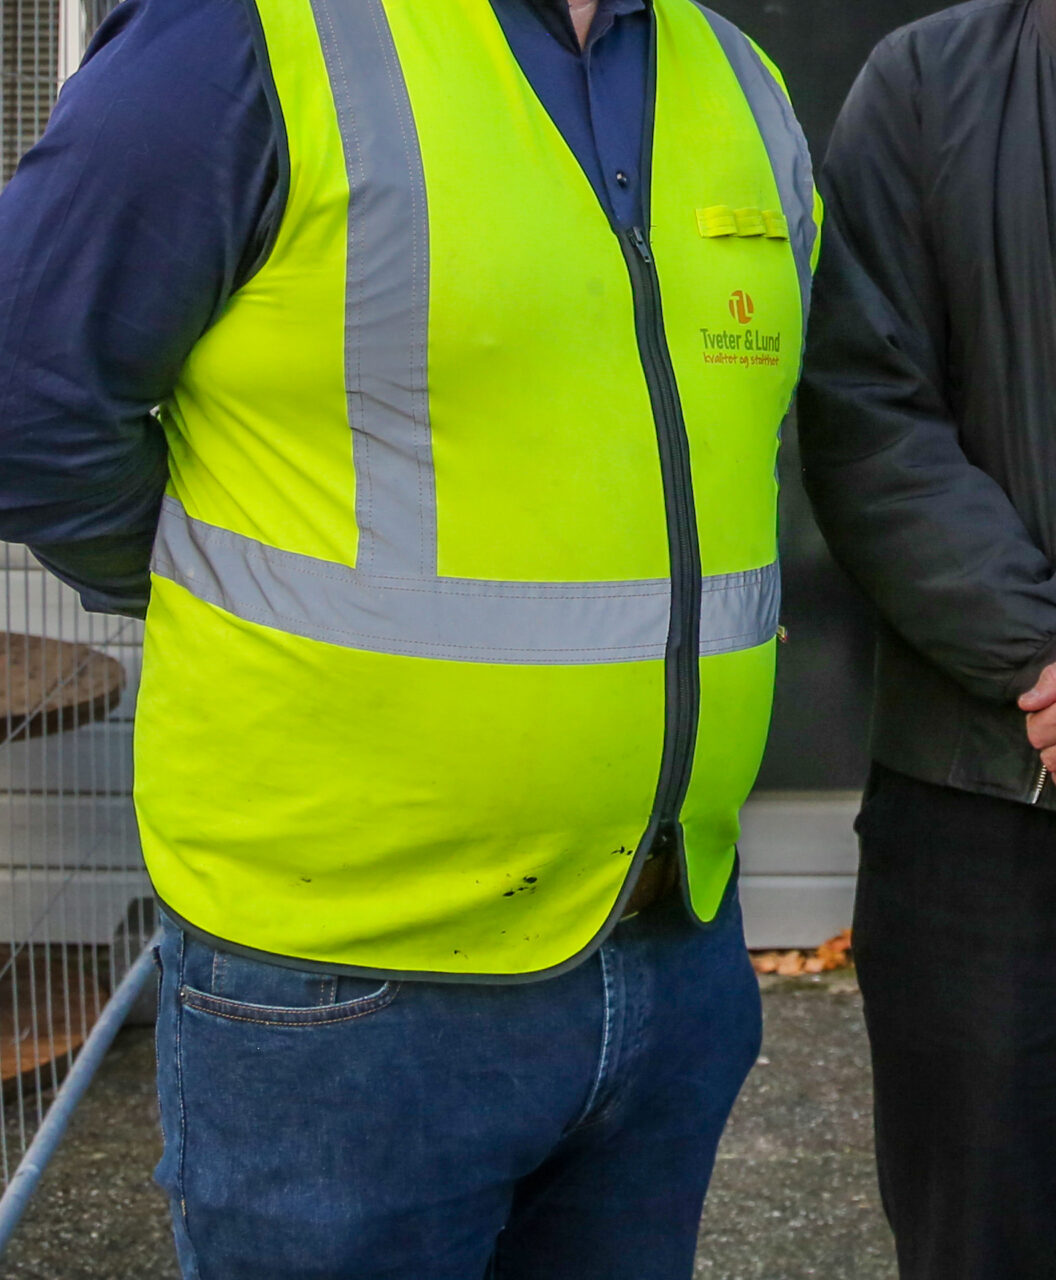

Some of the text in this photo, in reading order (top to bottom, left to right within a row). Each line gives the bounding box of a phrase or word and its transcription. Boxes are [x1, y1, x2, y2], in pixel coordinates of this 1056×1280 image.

[700, 328, 780, 352] Tveter & Lund
[739, 356, 749, 368] og
